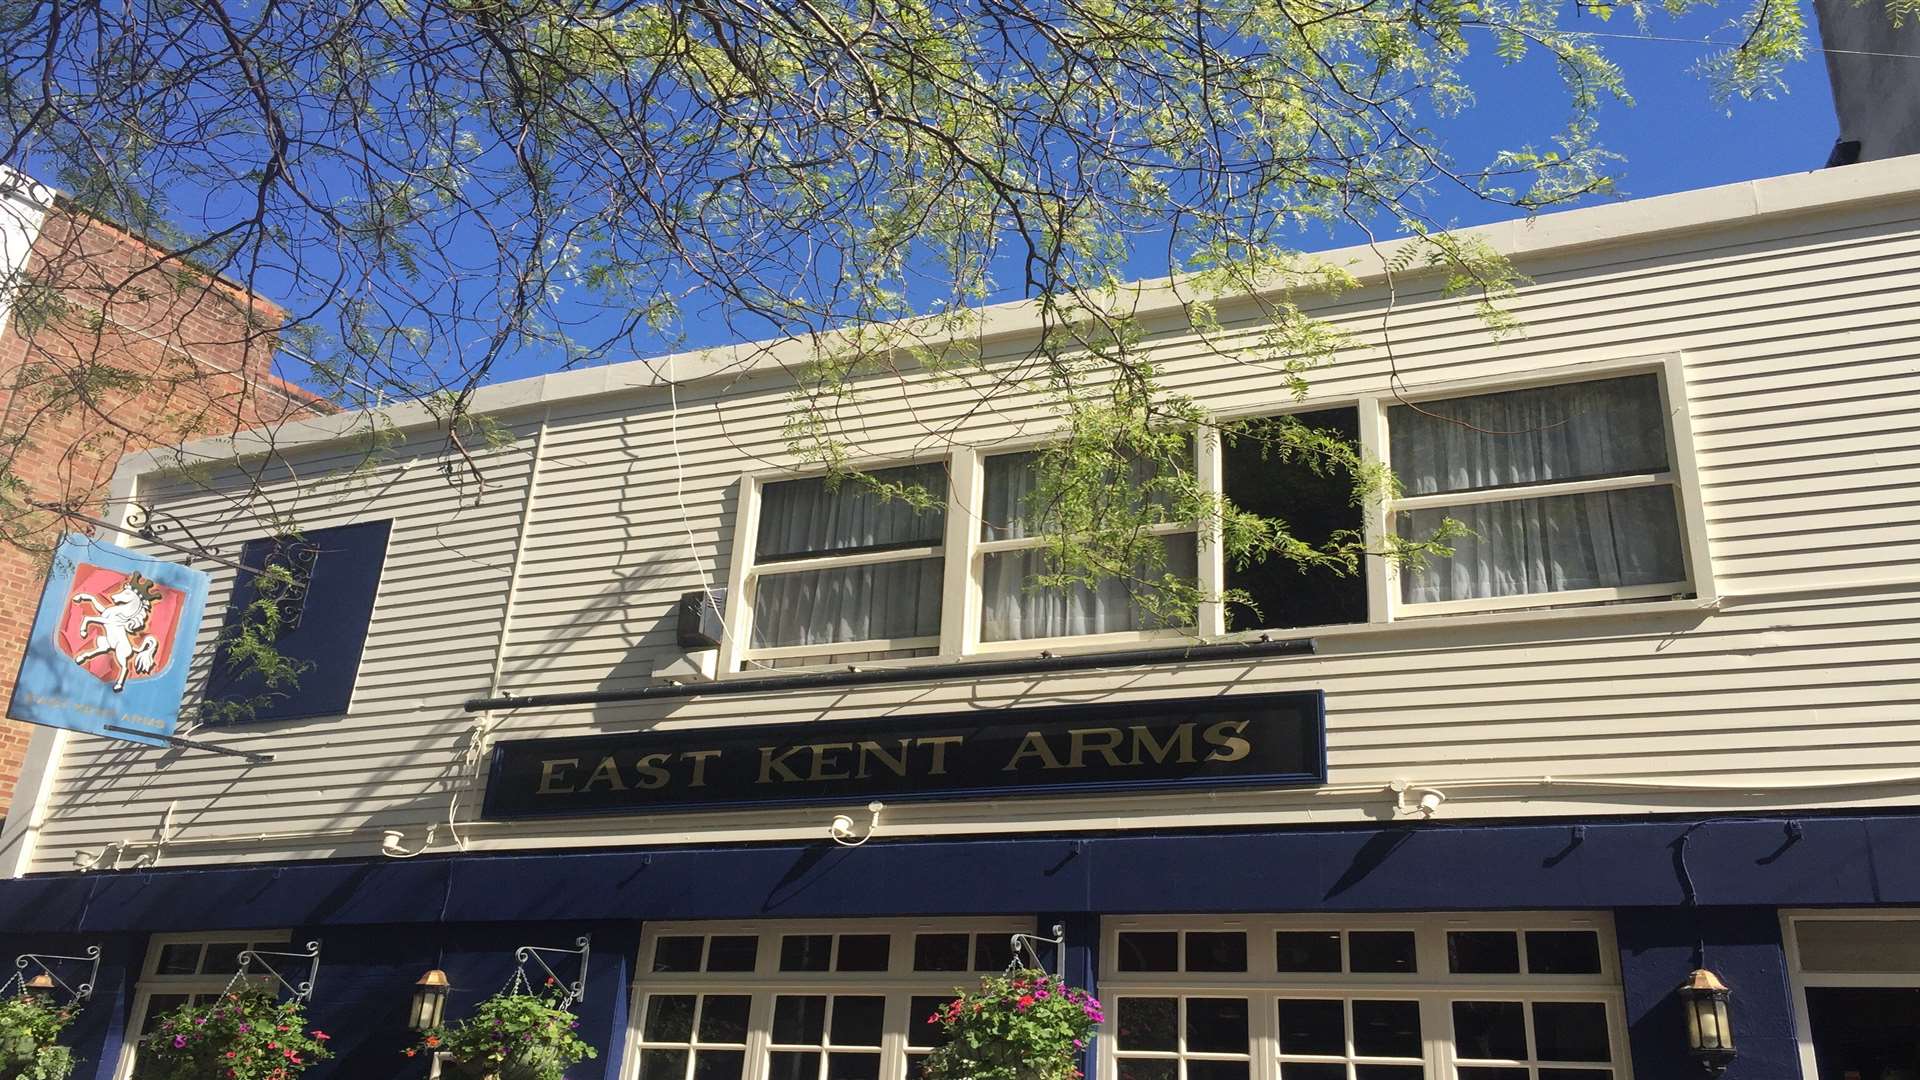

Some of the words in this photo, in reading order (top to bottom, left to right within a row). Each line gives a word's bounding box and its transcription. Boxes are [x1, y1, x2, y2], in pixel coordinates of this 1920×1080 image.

[536, 750, 722, 795] EAST
[754, 736, 963, 784] KENT
[1001, 719, 1252, 771] ARMS
